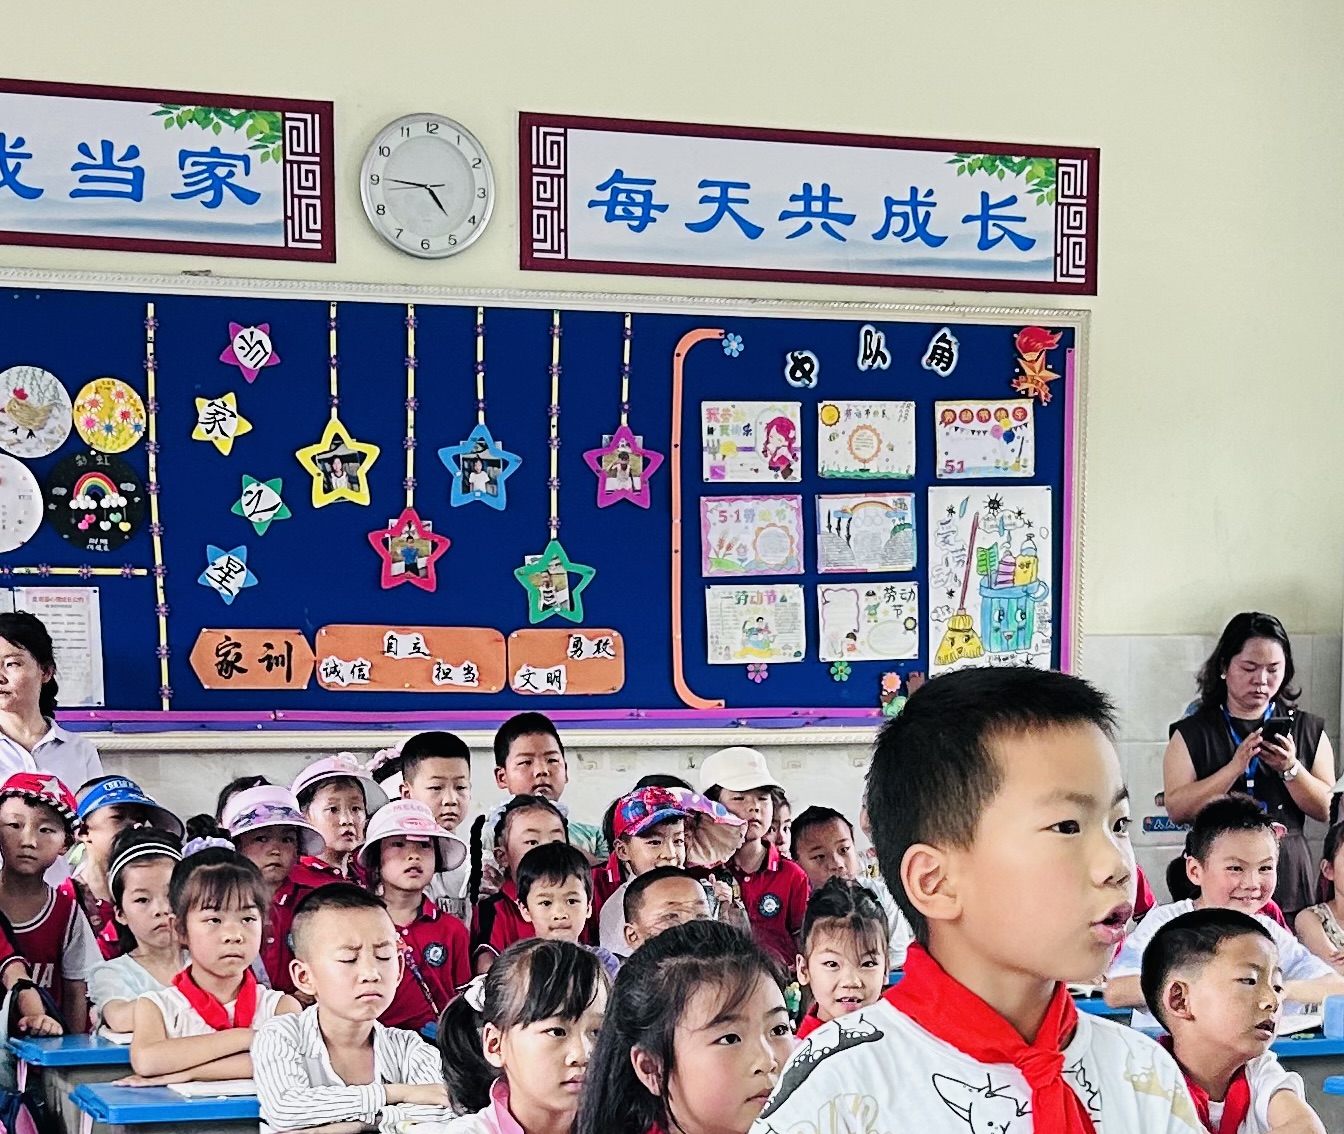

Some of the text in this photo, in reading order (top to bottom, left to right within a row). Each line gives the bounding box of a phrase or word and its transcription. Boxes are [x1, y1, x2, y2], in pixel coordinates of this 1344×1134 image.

[400, 125, 410, 138] 11
[426, 121, 439, 134] 12
[378, 145, 391, 157] 10
[472, 157, 482, 169] 2
[370, 173, 380, 185] 9
[477, 187, 486, 199] 3
[376, 204, 386, 216] 8
[587, 168, 1037, 252] 每天共成长
[468, 215, 476, 226] 4
[395, 228, 404, 239] 7
[420, 238, 430, 250] 6
[448, 234, 457, 246] 5
[944, 460, 965, 474] 51
[386, 634, 429, 656] 自立
[215, 635, 293, 682] 家训
[323, 660, 370, 682] 诚信
[435, 664, 478, 683] 担当
[520, 669, 563, 692] 文明
